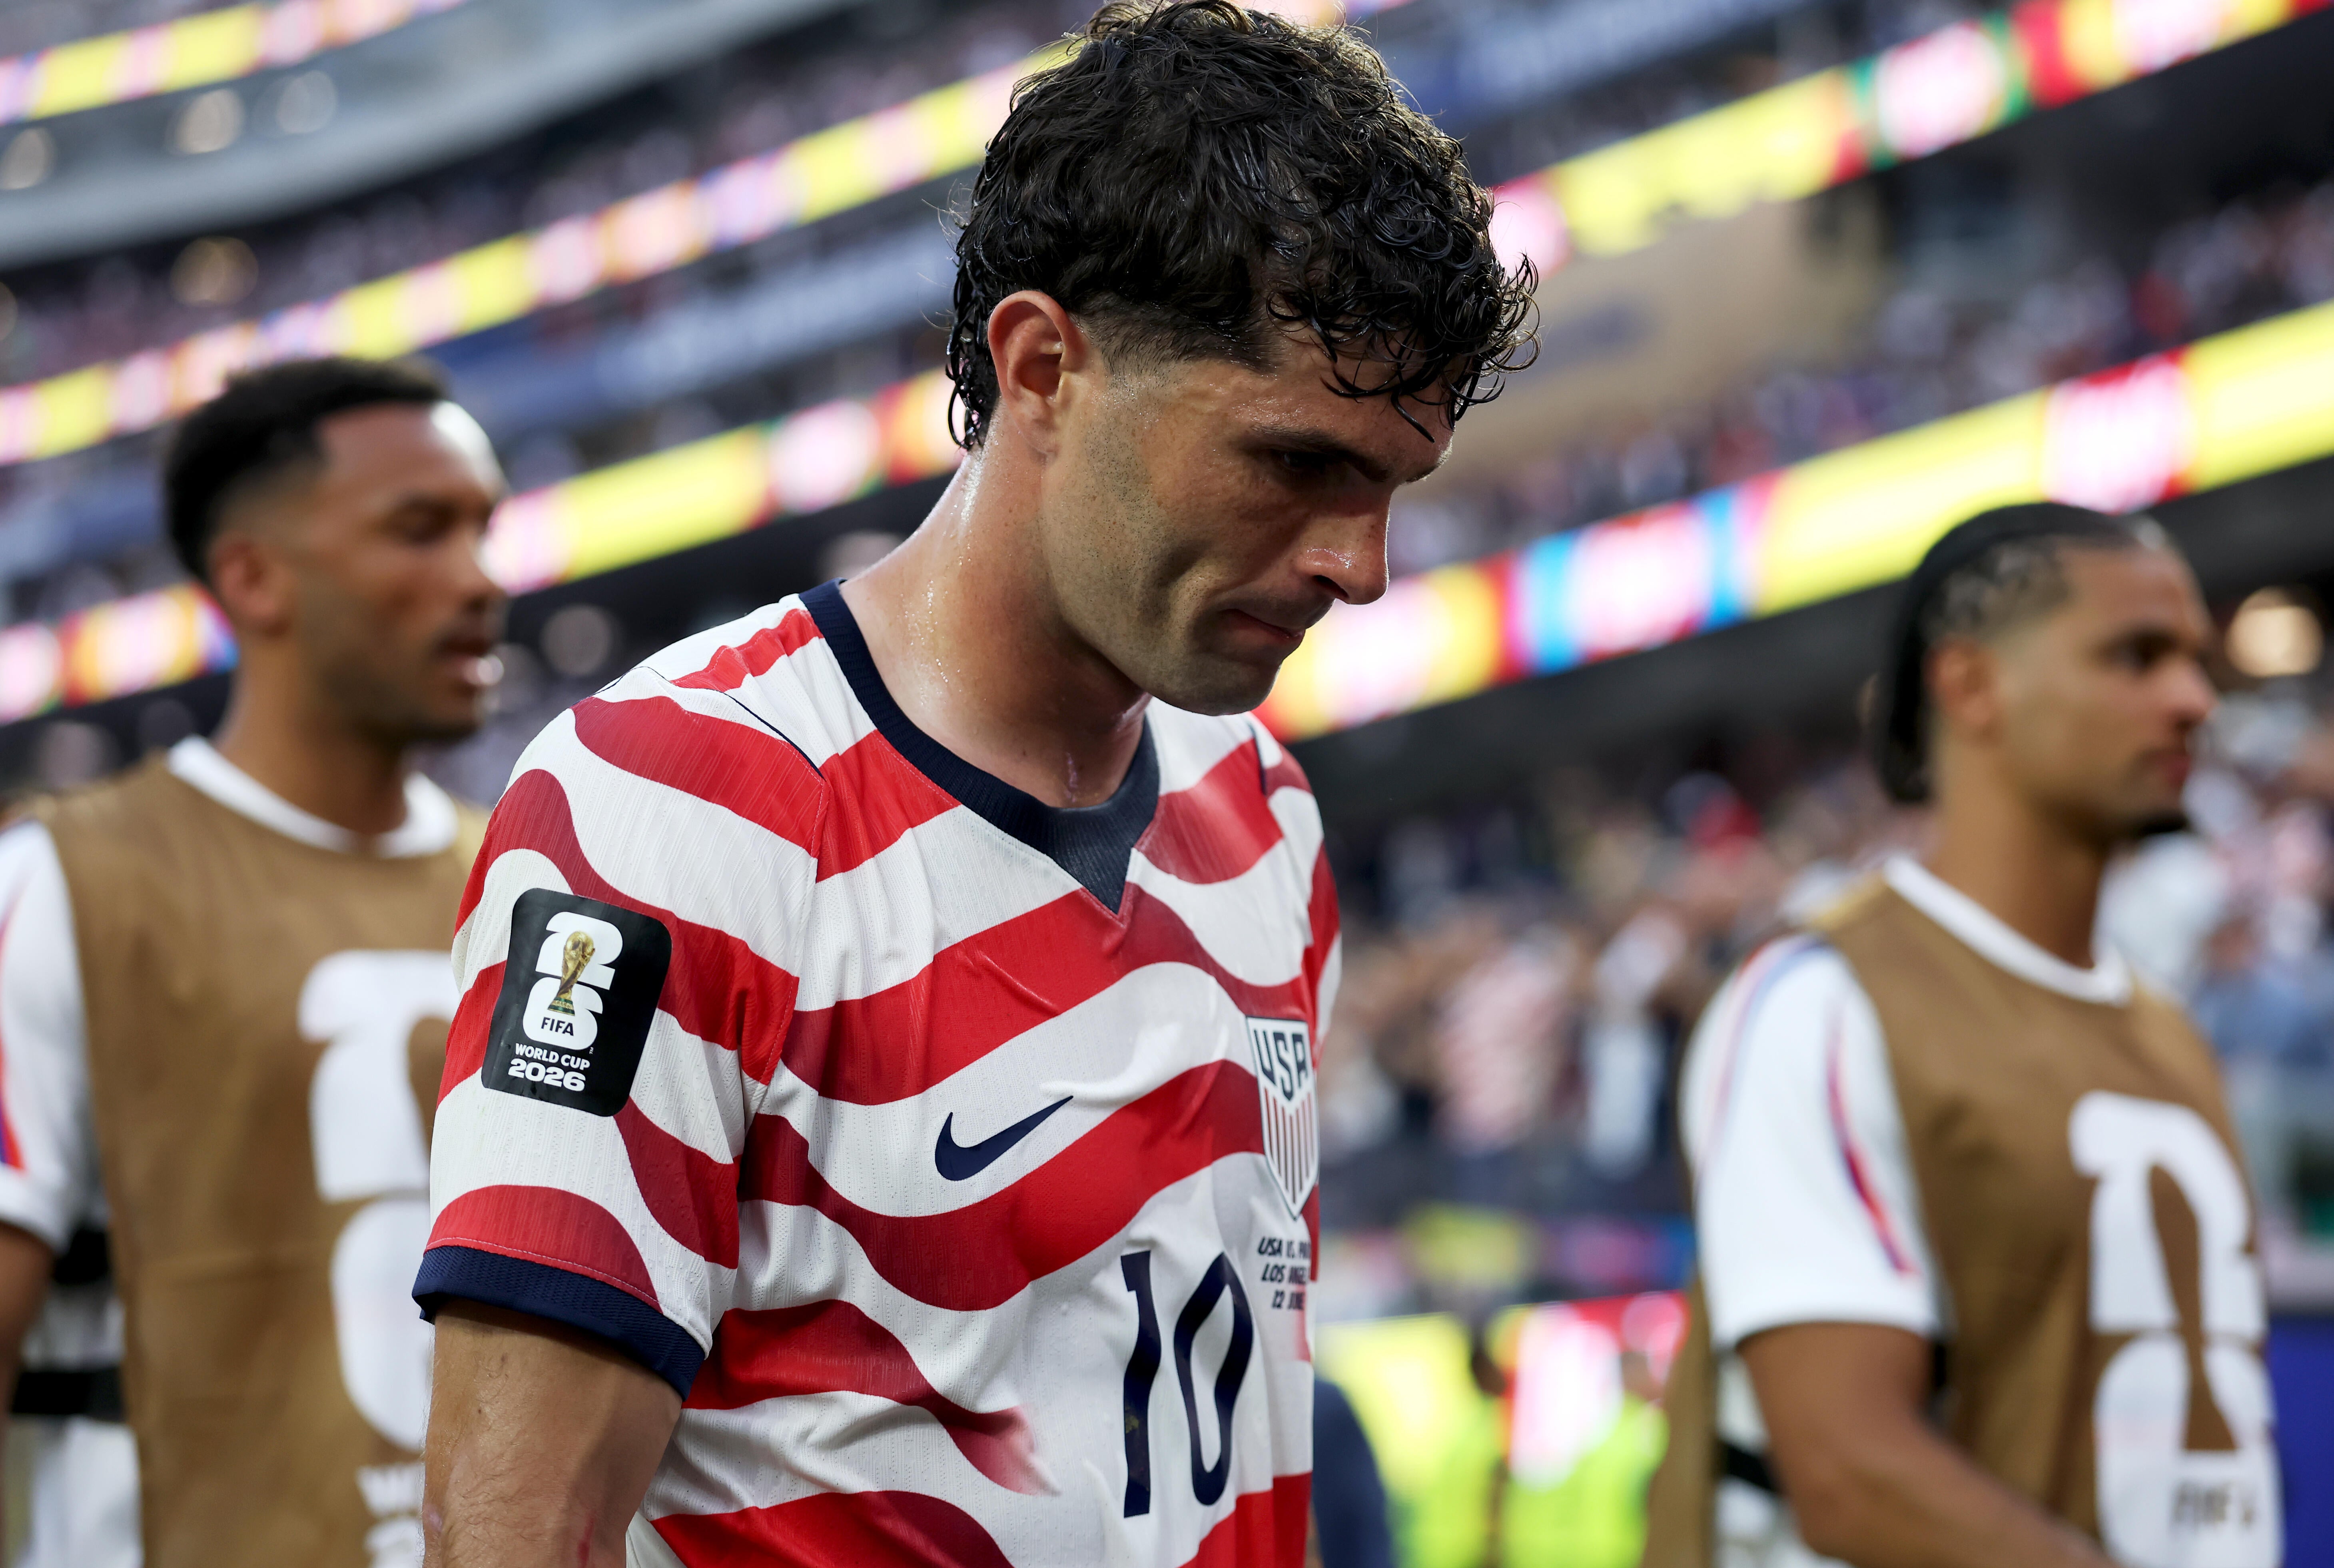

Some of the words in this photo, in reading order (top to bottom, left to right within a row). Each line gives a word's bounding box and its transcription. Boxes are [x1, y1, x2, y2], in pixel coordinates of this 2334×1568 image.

[541, 1017, 574, 1036] FIFA
[515, 1043, 559, 1063] WORLD
[561, 1054, 590, 1070] CUP
[1254, 1029, 1308, 1101] USA
[508, 1058, 586, 1091] 2026
[1258, 1237, 1282, 1256] USA
[1262, 1263, 1285, 1283] LOS
[1121, 1251, 1253, 1518] 10
